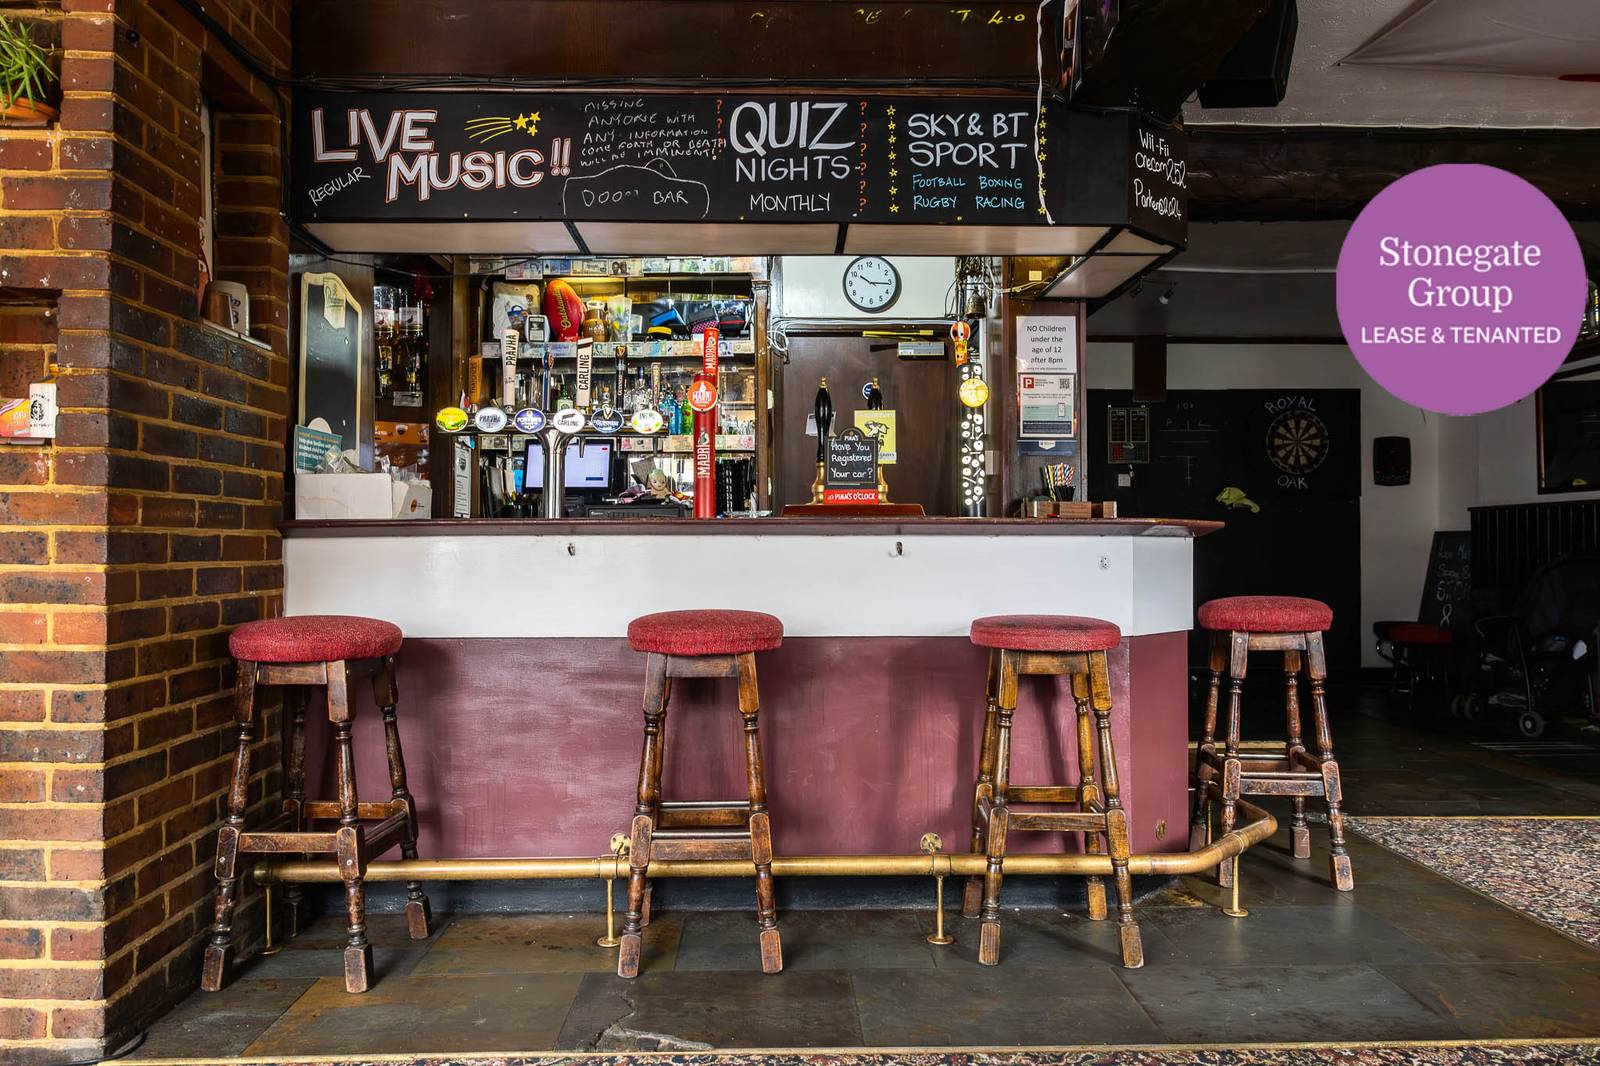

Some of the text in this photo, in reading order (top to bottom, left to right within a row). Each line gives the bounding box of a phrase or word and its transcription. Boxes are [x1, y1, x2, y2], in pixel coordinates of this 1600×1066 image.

[584, 98, 645, 113] MISSING
[666, 113, 696, 125] WITH
[993, 111, 1029, 139] BT
[311, 107, 438, 163] LIVE
[583, 129, 708, 145] ANY INFORMATION
[729, 101, 856, 157] QUIZ
[663, 139, 681, 149] OR
[908, 141, 1028, 170] SPORT
[385, 149, 545, 203] MUSIC
[735, 155, 850, 183] NIGHTS
[308, 166, 371, 207] REGULAR
[912, 173, 1023, 190] FOOTBALL BOXING
[653, 190, 689, 206] BAR
[750, 192, 831, 213] MONTHLY
[913, 195, 1025, 211] RUGBY RACING
[1038, 325, 1067, 333] Children
[505, 334, 517, 367] PRAVHA
[1047, 357, 1064, 365] 8pm
[578, 354, 590, 391] CARLING
[1264, 396, 1317, 415] ROYAL
[831, 438, 870, 452] Have You
[831, 453, 873, 467] Registered
[830, 467, 851, 479] Your
[1277, 474, 1309, 489] OAK
